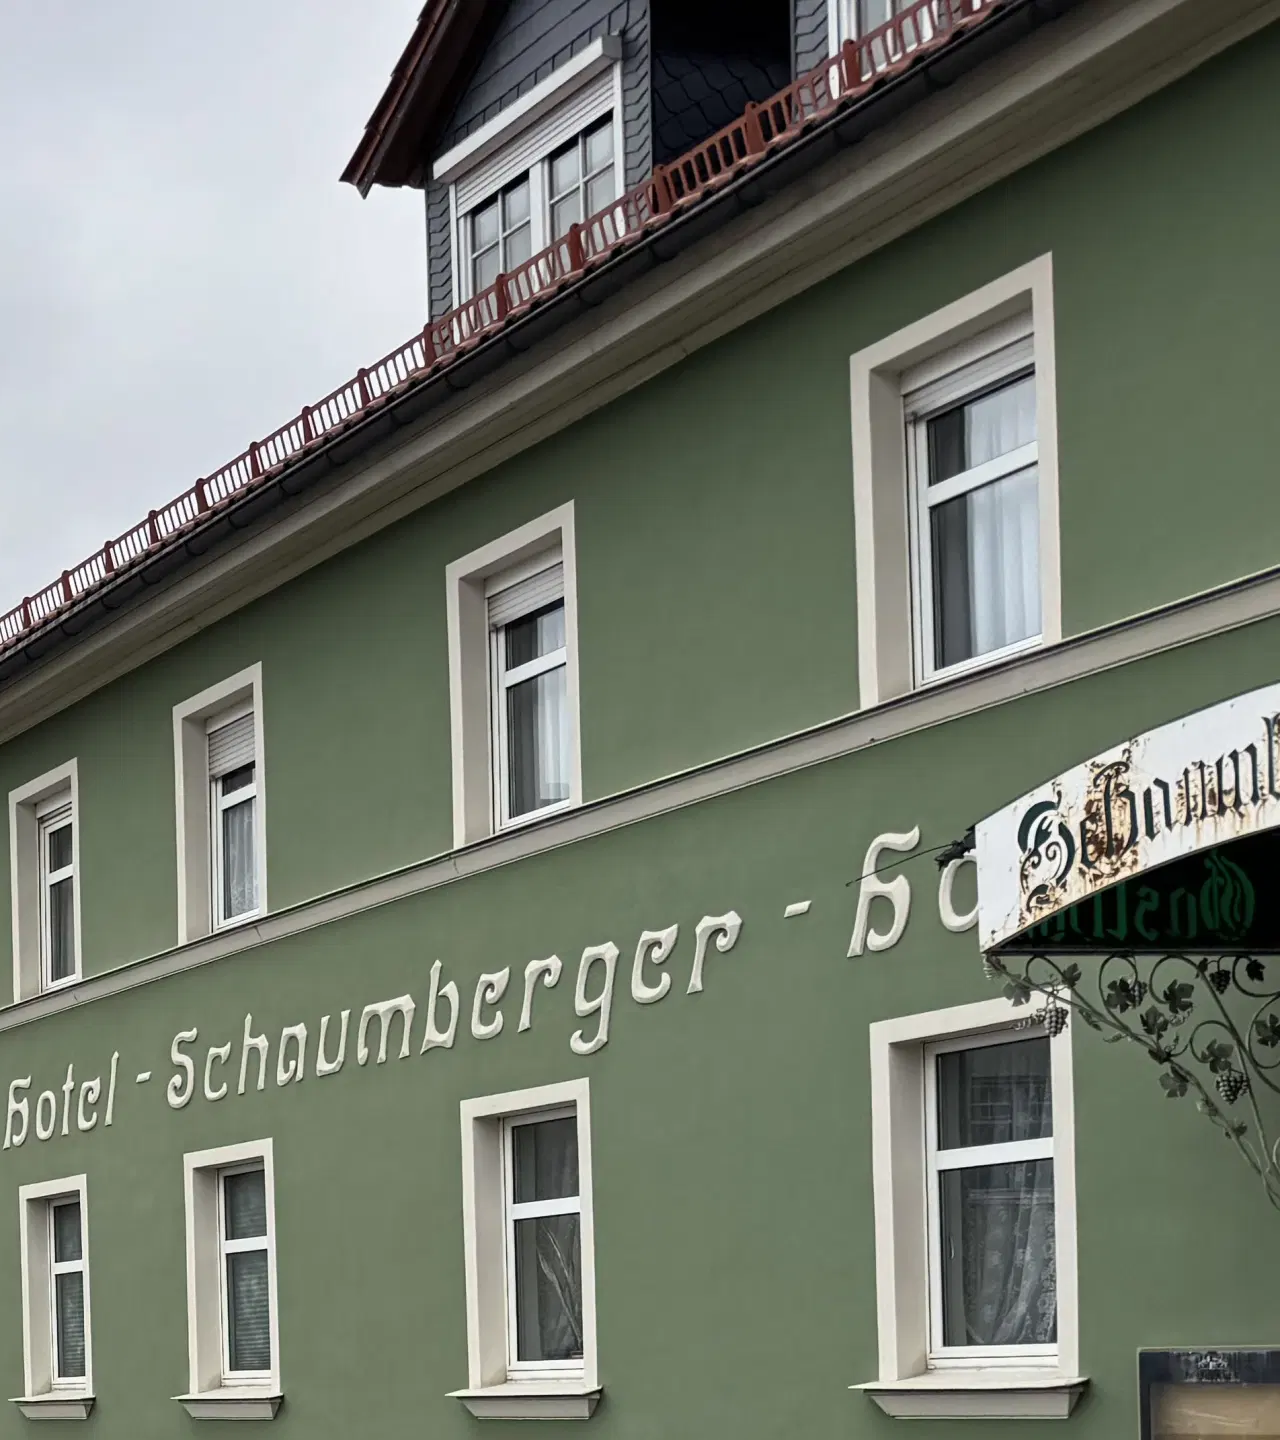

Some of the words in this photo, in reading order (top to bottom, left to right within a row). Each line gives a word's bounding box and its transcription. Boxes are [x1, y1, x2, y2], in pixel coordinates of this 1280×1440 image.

[3, 1050, 120, 1151] Hotel
[166, 909, 743, 1110] Schaumberger
[846, 825, 980, 958] Ho
